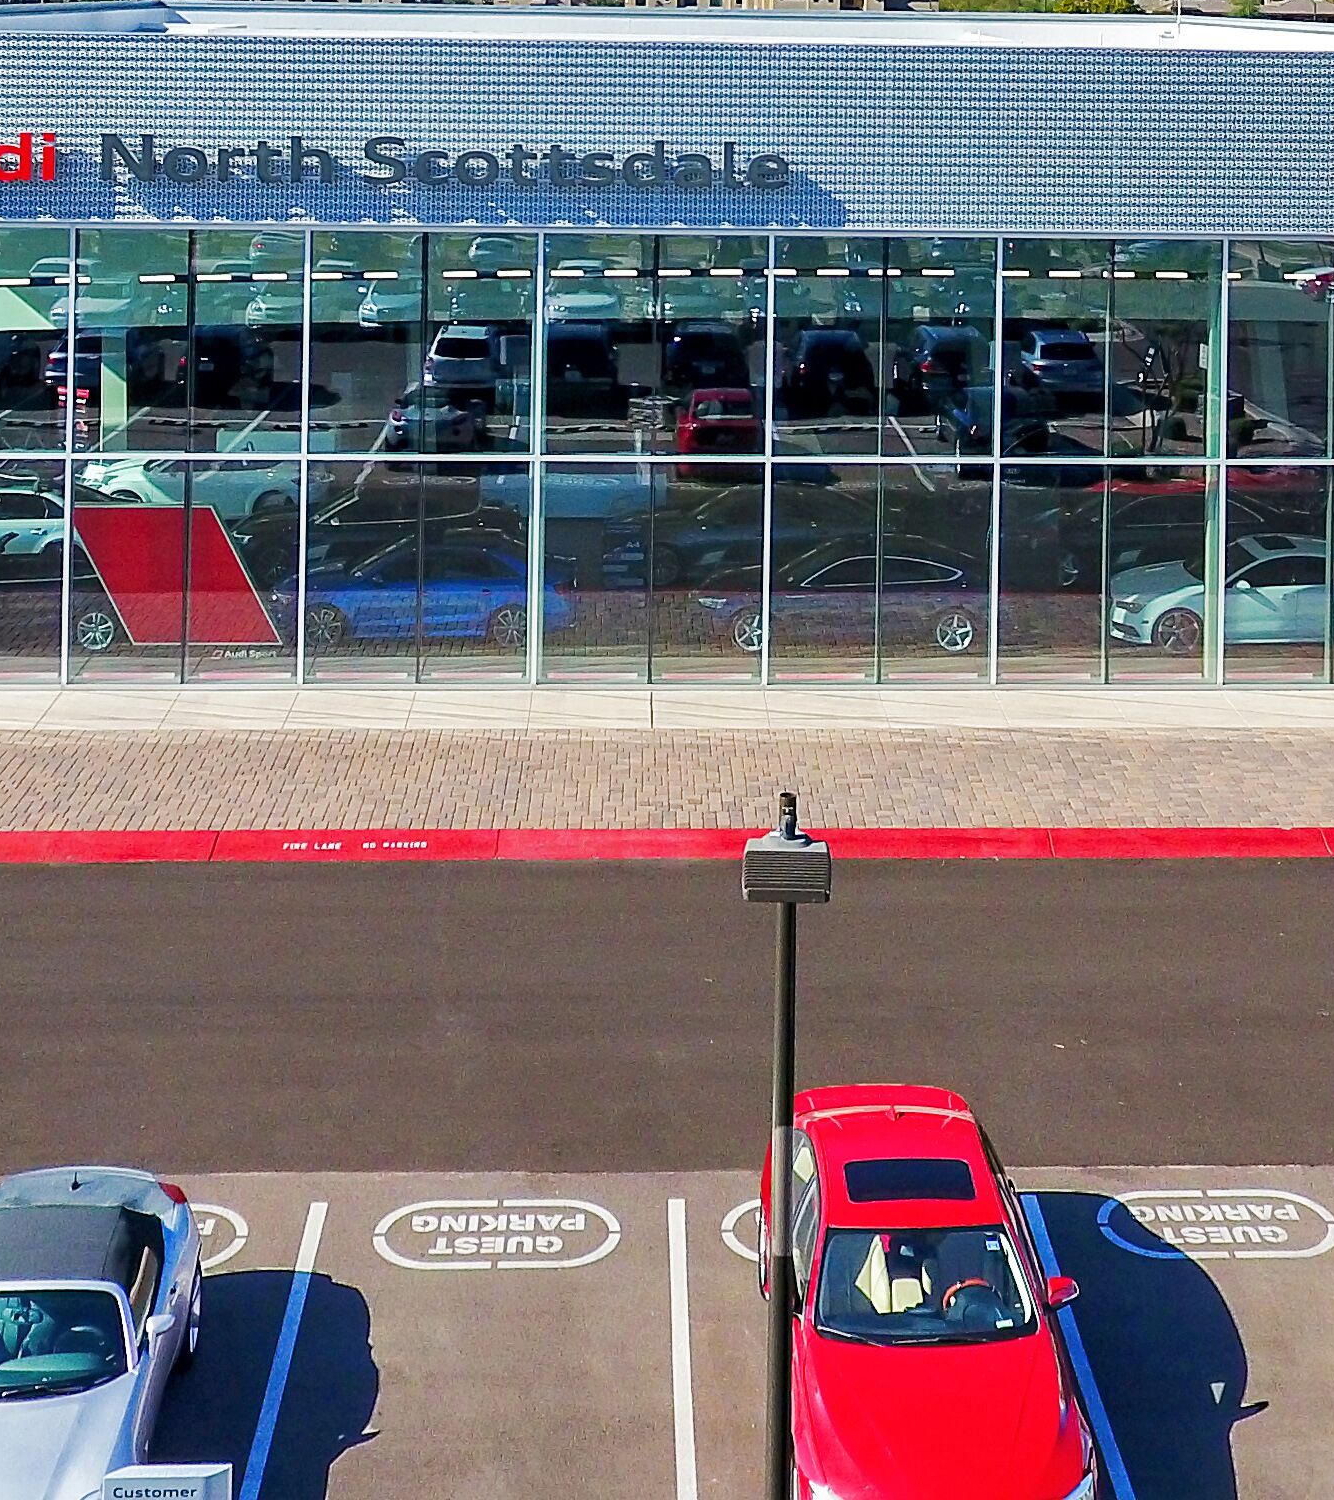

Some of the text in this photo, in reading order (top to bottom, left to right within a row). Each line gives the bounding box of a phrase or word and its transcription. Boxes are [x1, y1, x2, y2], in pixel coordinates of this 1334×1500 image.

[100, 133, 334, 184] North
[364, 136, 789, 188] Scottsdale
[224, 650, 277, 659] Audi Sport
[1128, 1204, 1300, 1222] PARKING
[410, 1214, 585, 1232] PARKING
[1161, 1226, 1288, 1244] GUEST
[428, 1235, 563, 1254] GUEST
[113, 1487, 197, 1498] Customer
